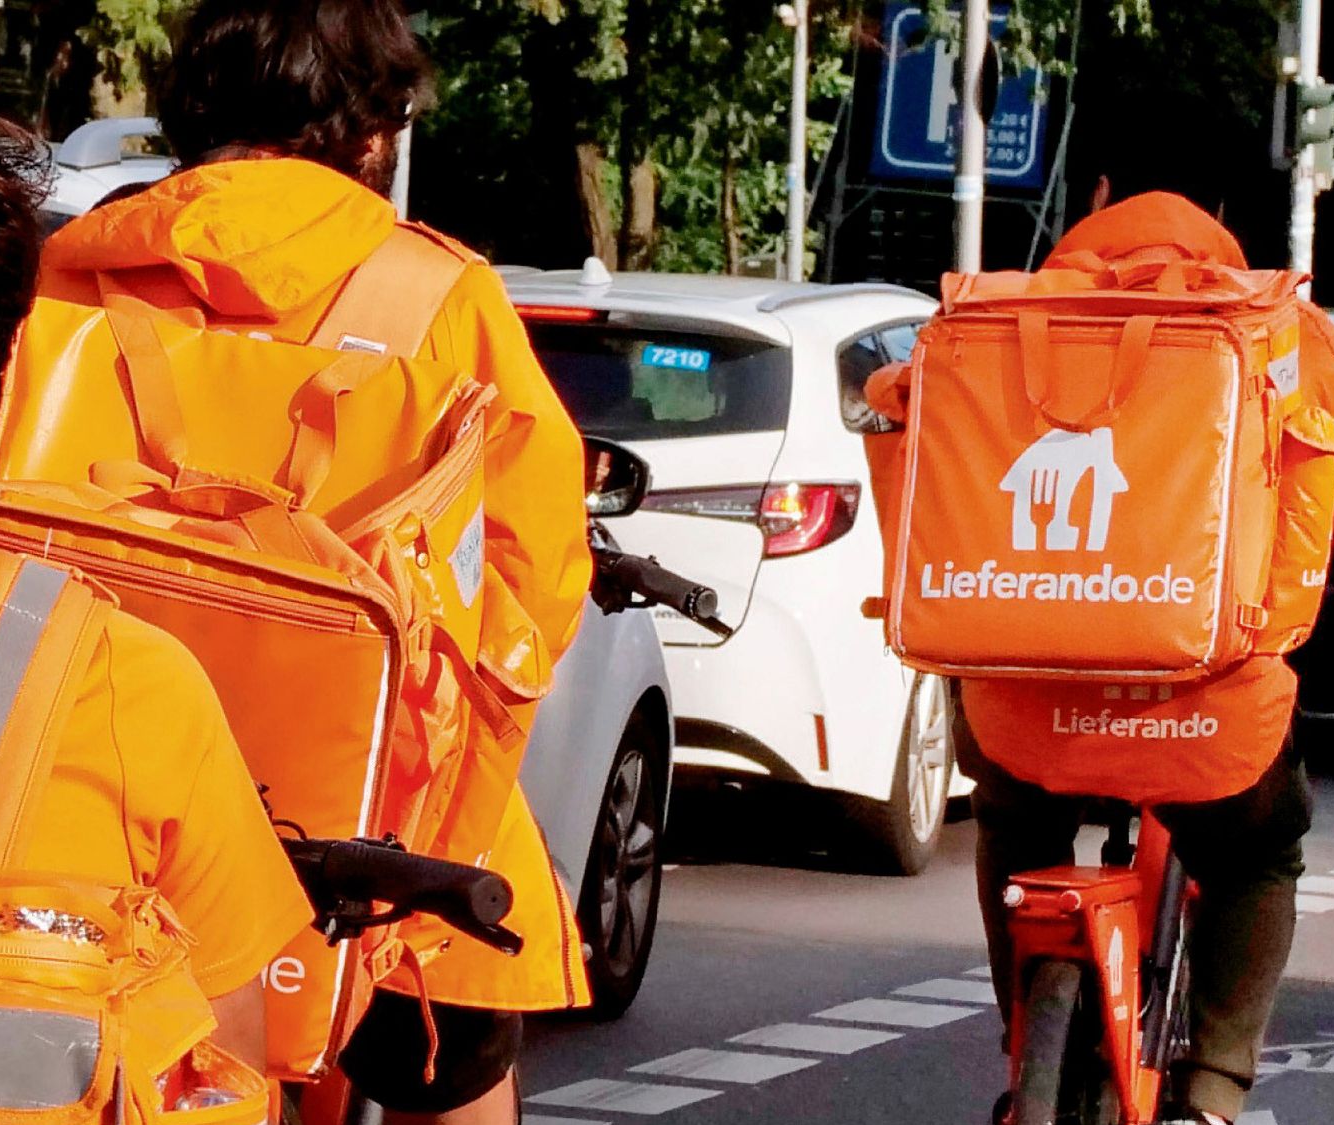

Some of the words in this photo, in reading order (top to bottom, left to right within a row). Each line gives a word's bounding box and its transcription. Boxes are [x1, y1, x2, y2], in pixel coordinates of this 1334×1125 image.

[651, 346, 703, 368] 7210
[921, 559, 1195, 604] Lieferando.de
[1052, 708, 1218, 739] Lieferando
